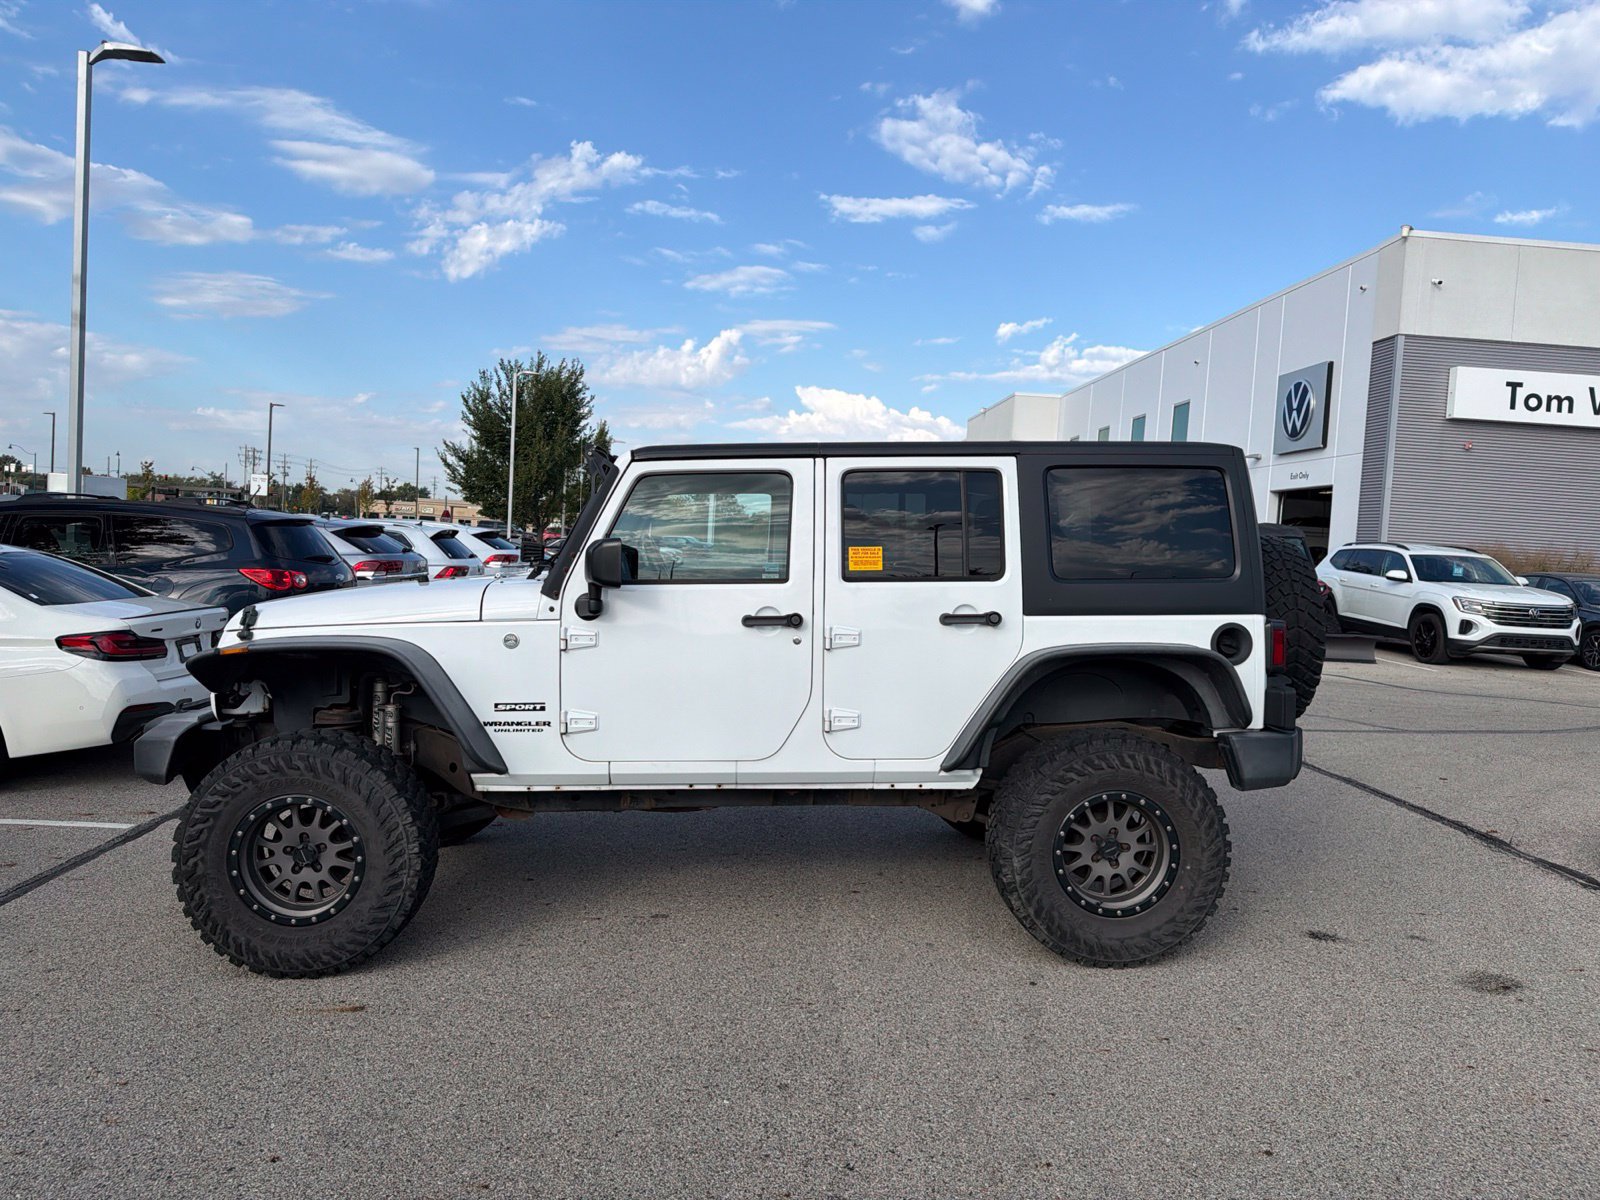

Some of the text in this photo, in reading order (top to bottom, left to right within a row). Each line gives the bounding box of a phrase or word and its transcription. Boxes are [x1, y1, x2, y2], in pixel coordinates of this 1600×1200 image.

[1506, 381, 1574, 413] Tom
[1290, 471, 1310, 480] Exit Only
